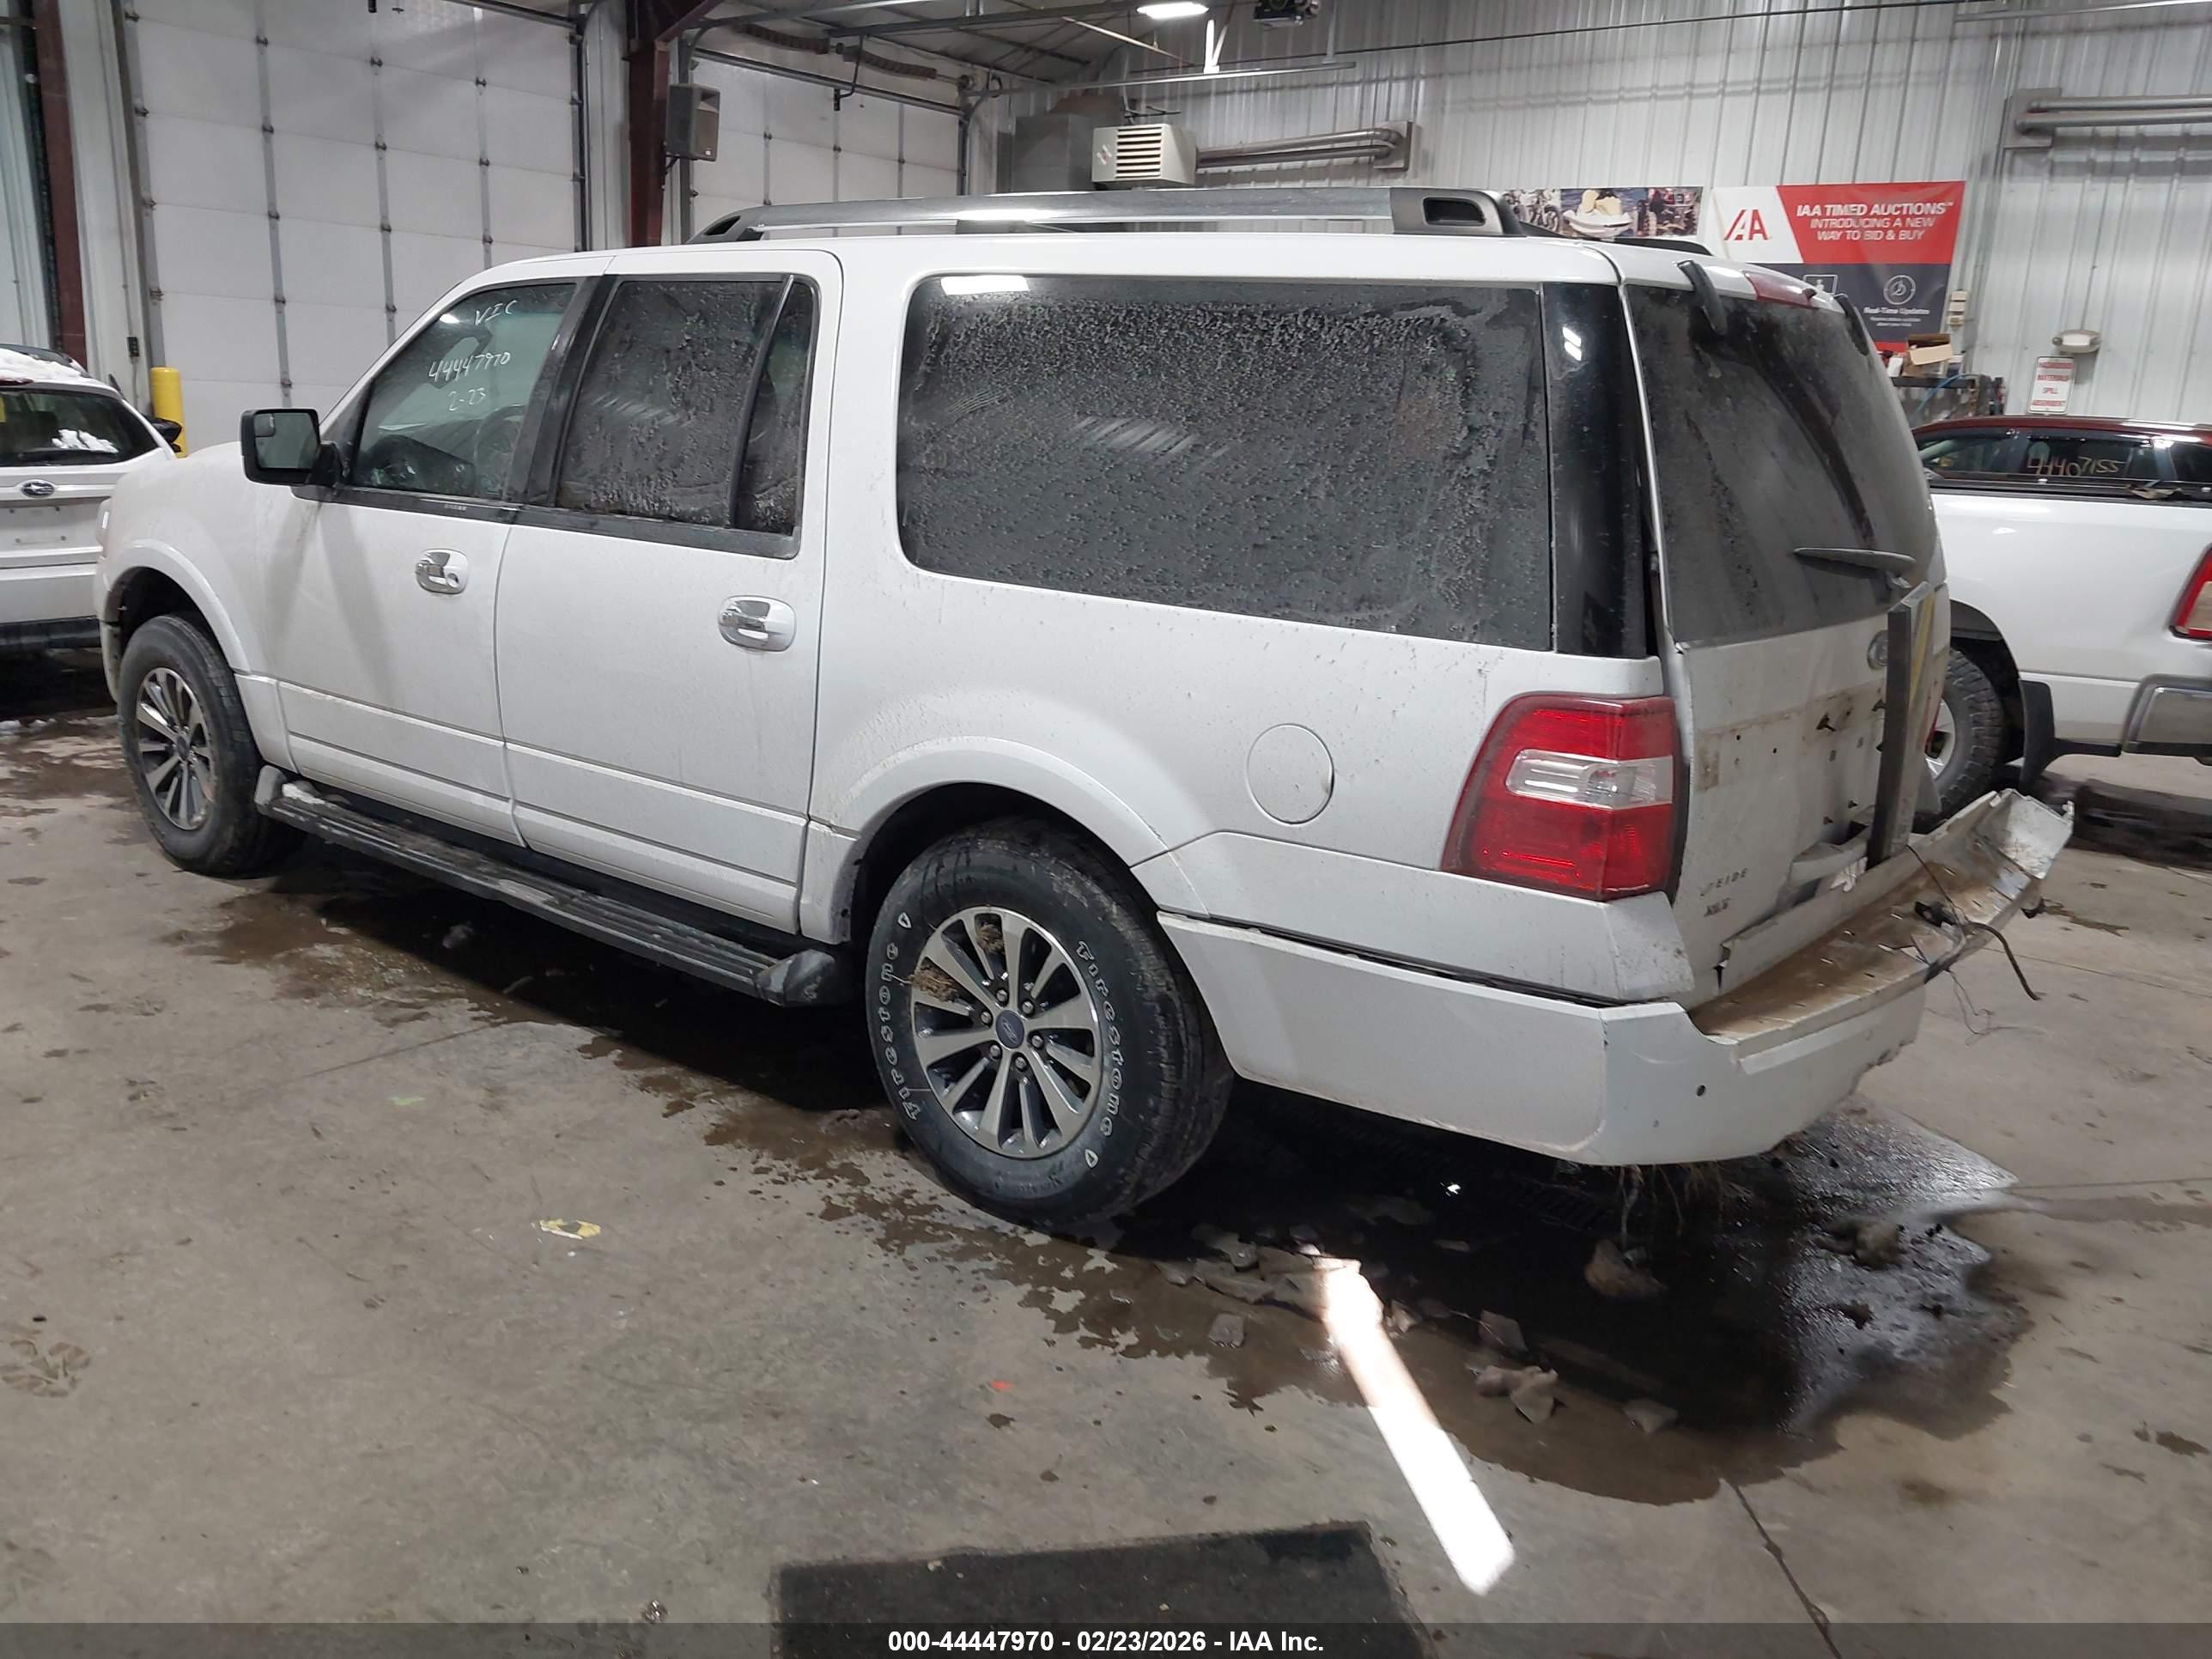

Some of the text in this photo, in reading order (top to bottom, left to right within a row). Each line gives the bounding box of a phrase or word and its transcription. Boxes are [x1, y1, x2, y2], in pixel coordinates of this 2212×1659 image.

[1796, 204, 1821, 216] IAA
[1824, 204, 1868, 216] TIMED
[1810, 217, 1936, 229] INTRODUCING A NEW
[1817, 229, 1926, 240] WAY TO BID & BUY
[428, 351, 512, 383] 44447970
